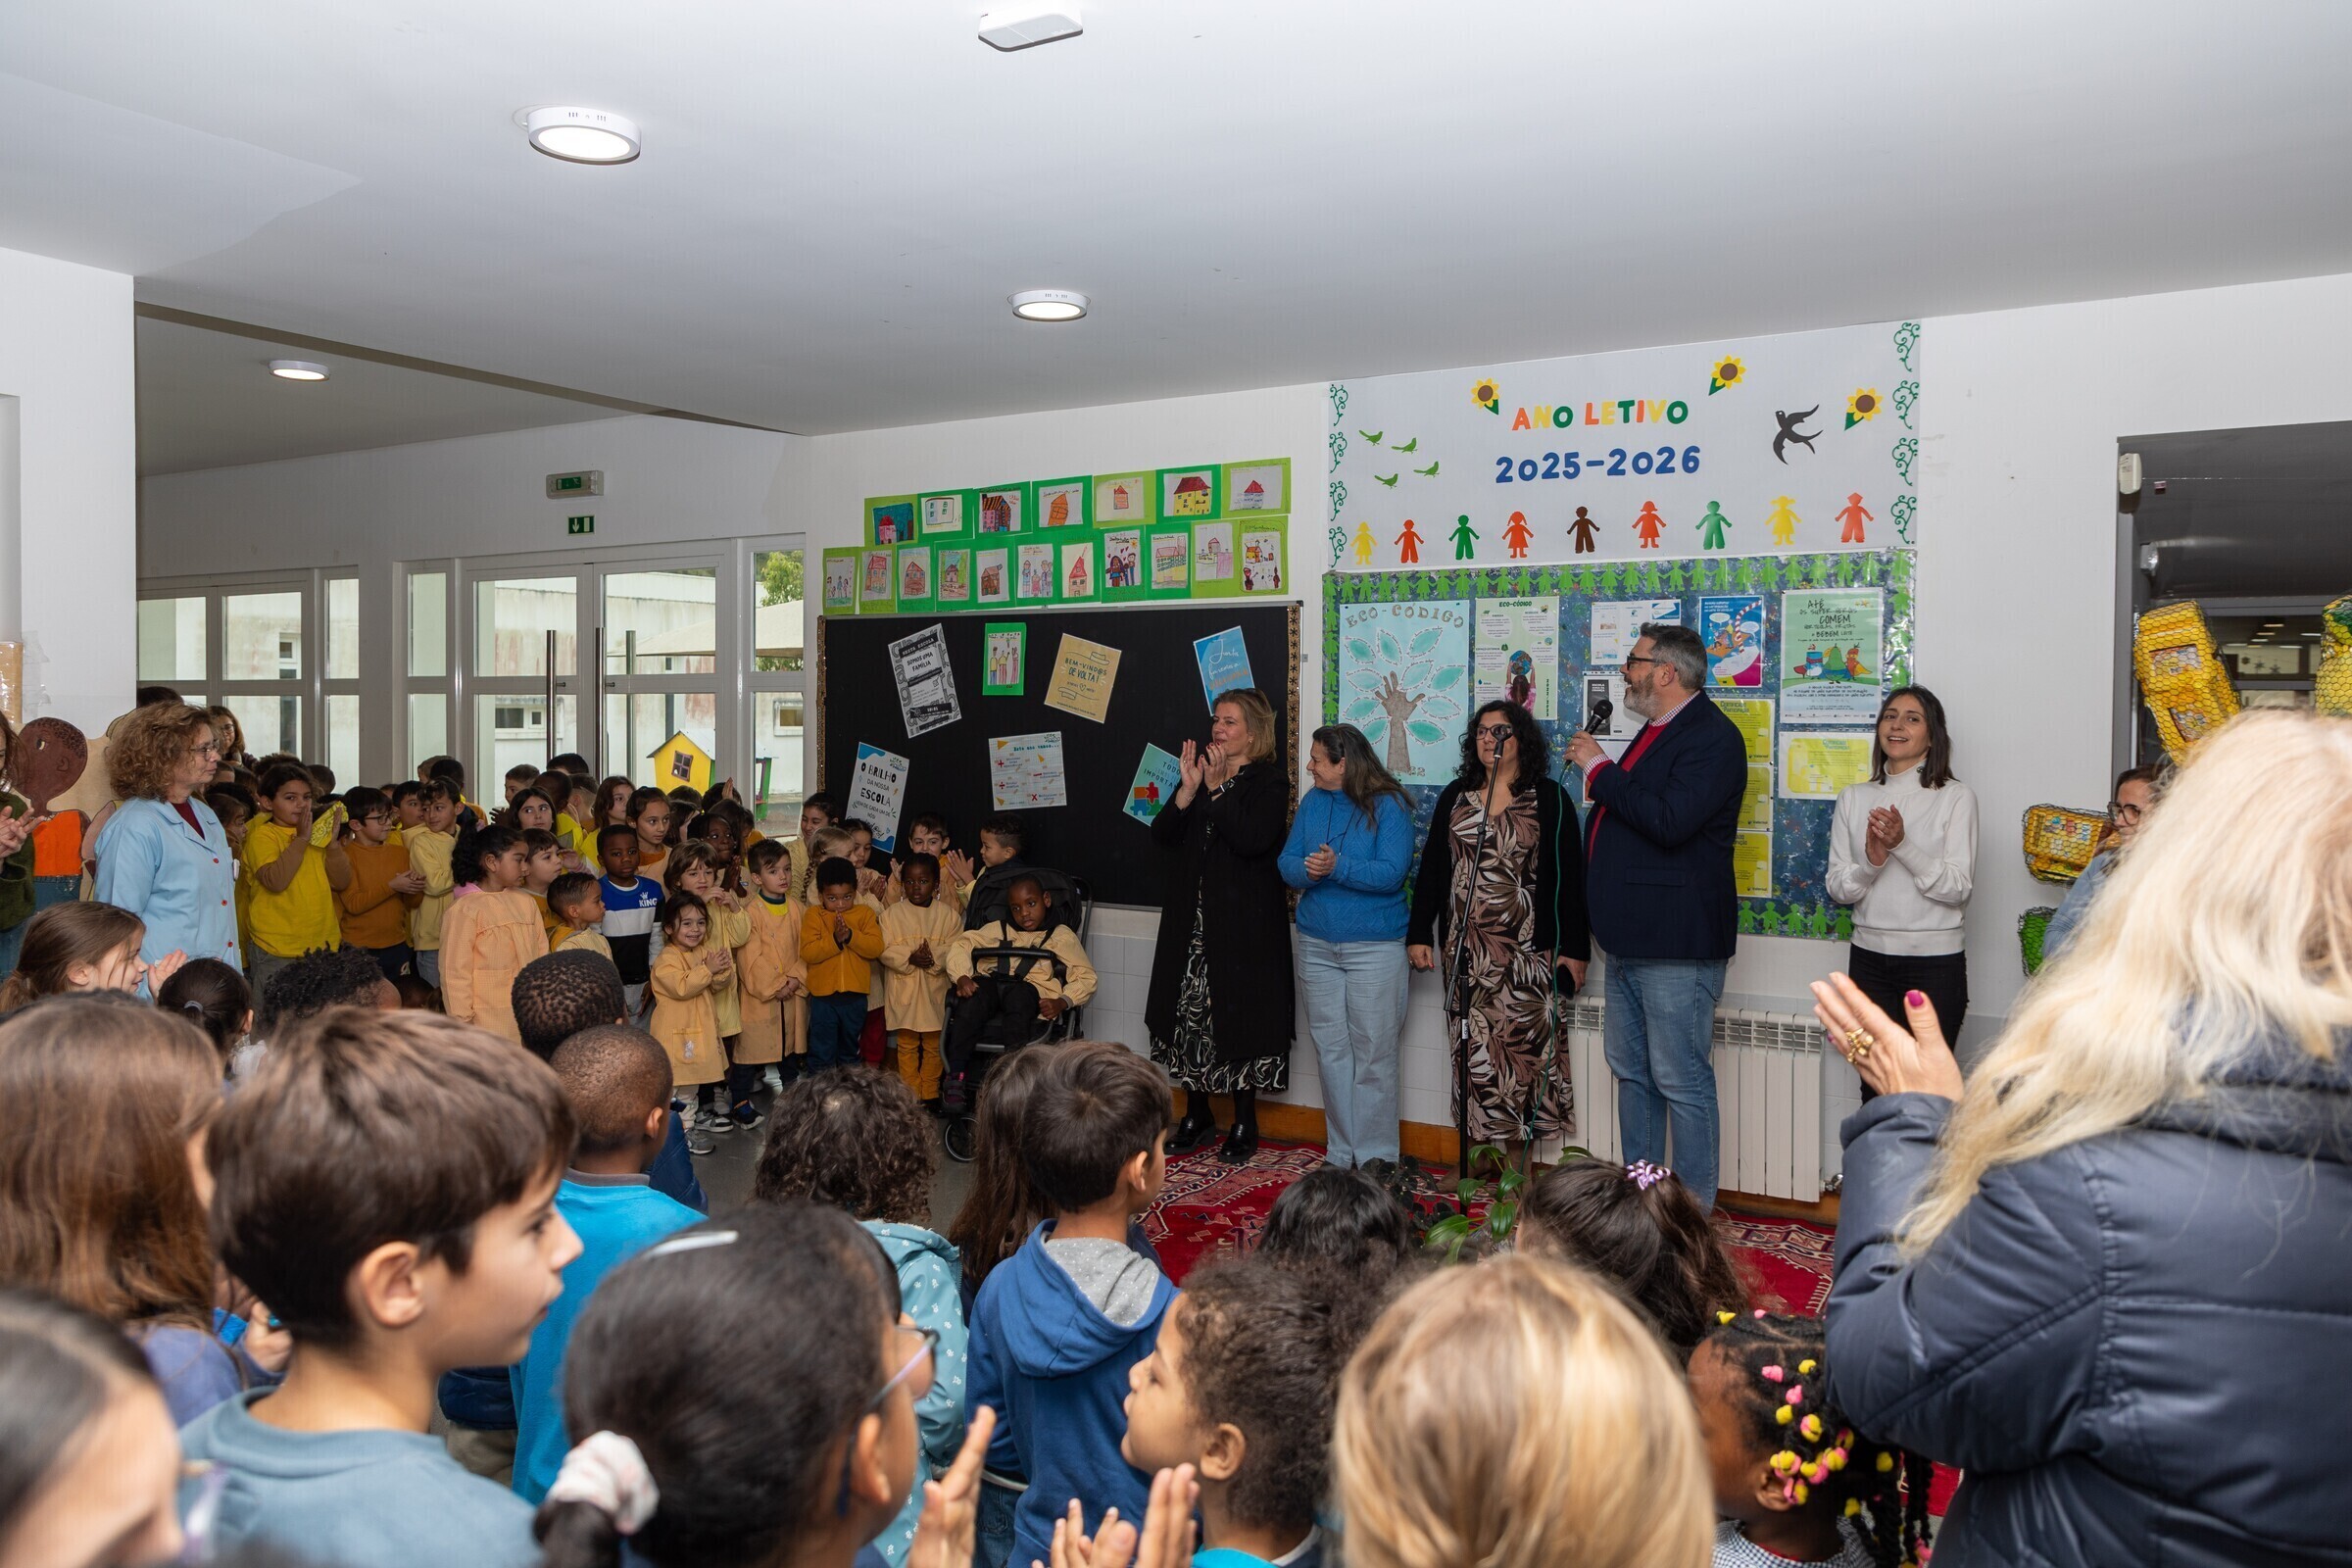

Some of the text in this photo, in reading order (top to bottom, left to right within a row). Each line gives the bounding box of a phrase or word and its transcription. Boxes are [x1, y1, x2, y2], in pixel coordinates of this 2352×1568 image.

[1512, 400, 1689, 430] ANO LETIVO
[1495, 445, 1700, 483] 2025-2026
[1819, 614, 1850, 625] COMEM
[906, 655, 922, 666] SOMOS
[911, 660, 932, 672] FAMÍLIA
[1064, 657, 1107, 676] BEM-VIND@S
[1068, 666, 1100, 684] DE VOLTA!
[860, 761, 897, 783] O BRILHO
[859, 787, 891, 808] ESCOLA
[639, 898, 658, 907] KING
